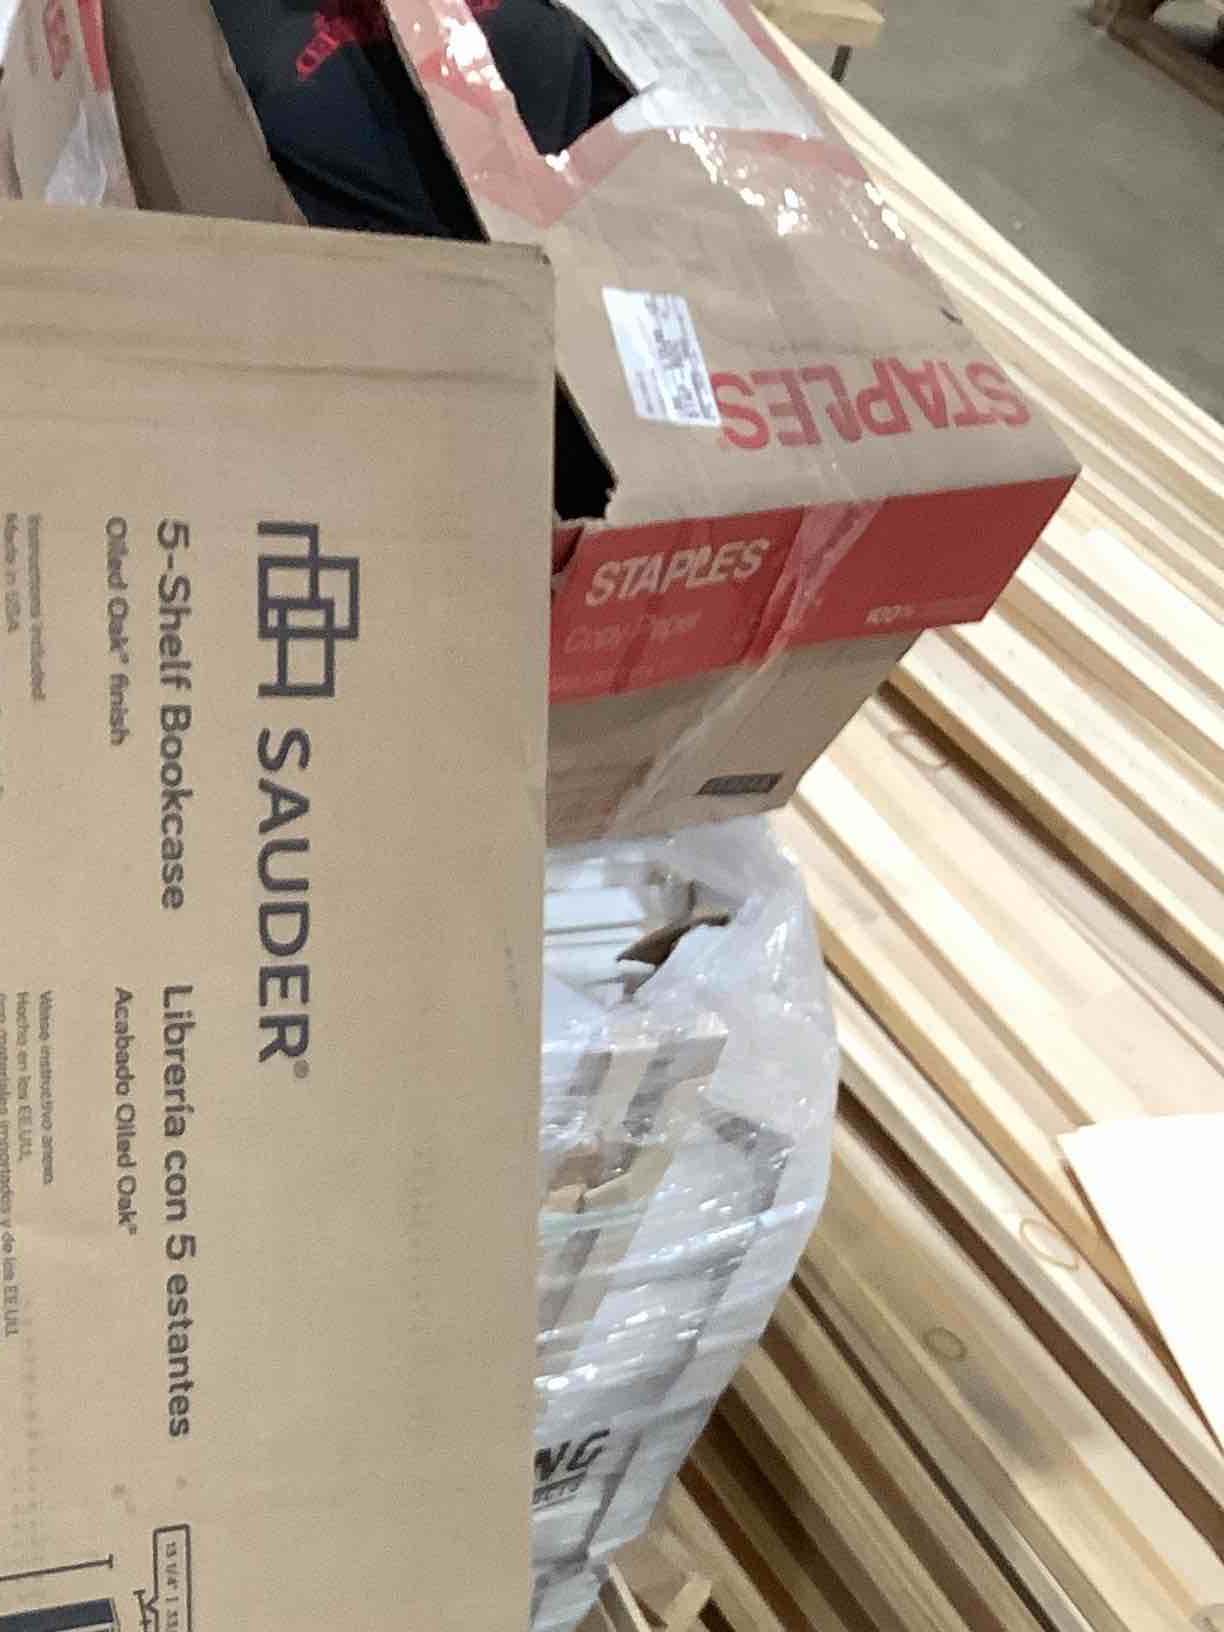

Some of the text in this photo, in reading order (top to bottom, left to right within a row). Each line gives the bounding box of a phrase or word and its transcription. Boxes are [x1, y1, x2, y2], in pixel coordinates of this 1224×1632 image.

[711, 358, 1031, 450] STAPLES
[105, 517, 129, 590] Oiled
[585, 537, 771, 607] STAPLES
[108, 674, 129, 746] finish
[156, 518, 193, 910] 5-Shelf Bookcase
[113, 987, 135, 1096] Acabado
[114, 1103, 136, 1167] Oiled
[161, 984, 196, 1437] Librería con 5 estantes
